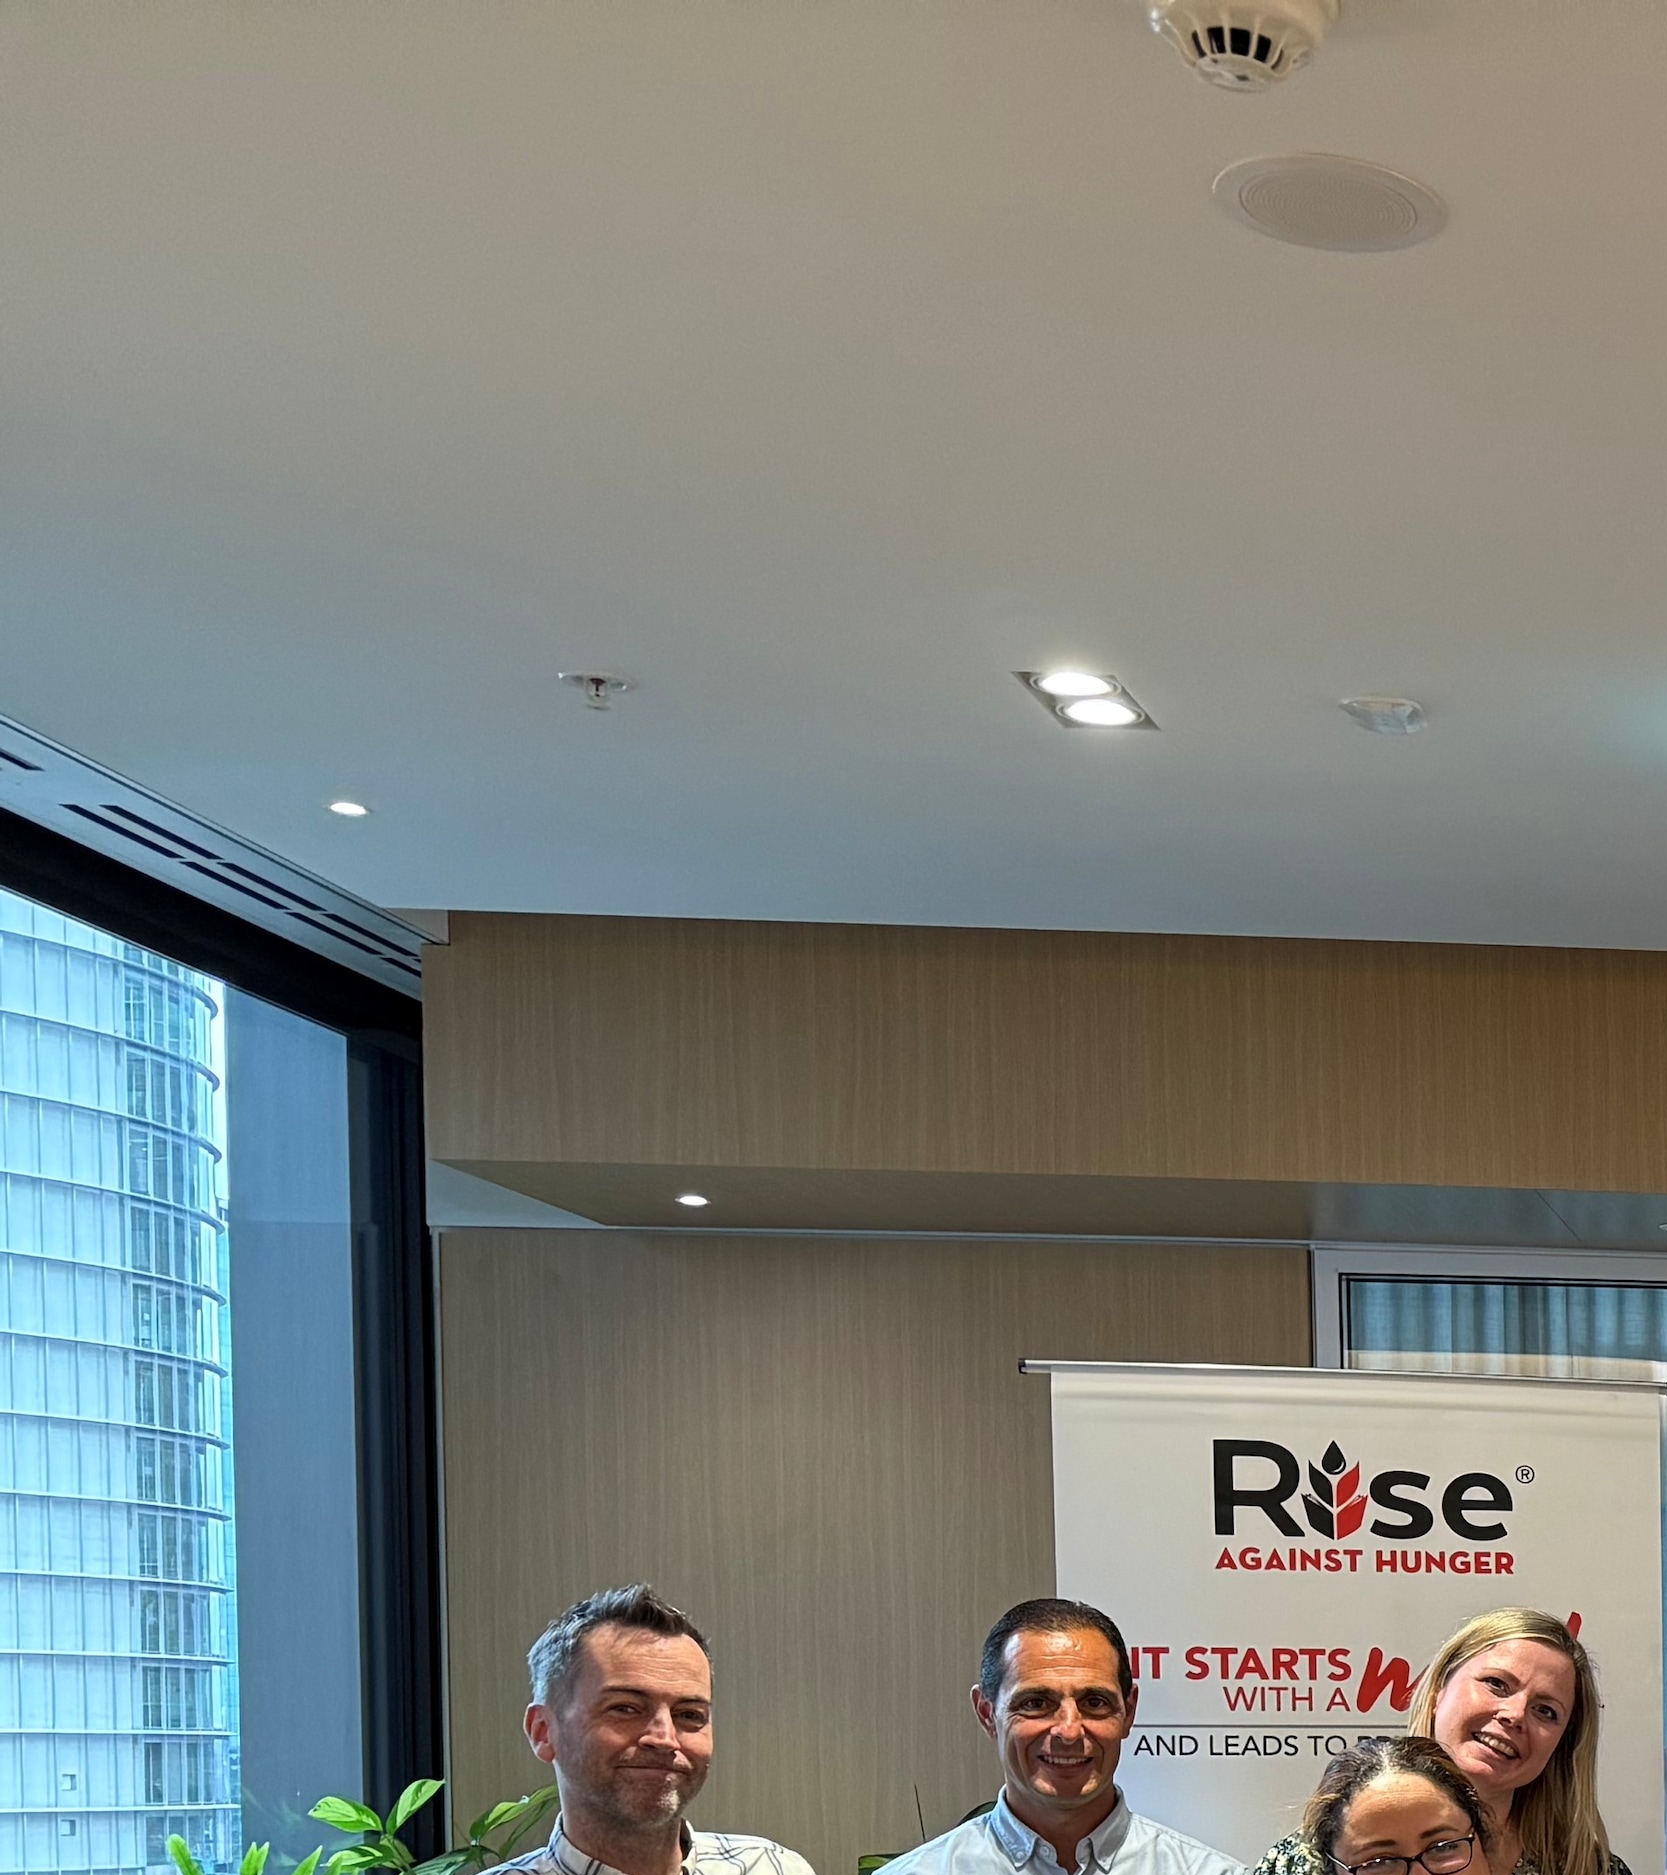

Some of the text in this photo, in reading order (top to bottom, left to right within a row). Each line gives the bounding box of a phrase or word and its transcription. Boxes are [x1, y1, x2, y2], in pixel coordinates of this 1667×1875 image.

[1213, 1439, 1514, 1541] Rise
[1215, 1546, 1515, 1575] AGAINST HUNGER
[1131, 1646, 1169, 1680] IT
[1185, 1646, 1351, 1682] STARTS
[1224, 1685, 1350, 1712] WITH A
[1134, 1734, 1199, 1757] AND
[1210, 1734, 1300, 1758] LEADS
[1309, 1735, 1348, 1756] TO
